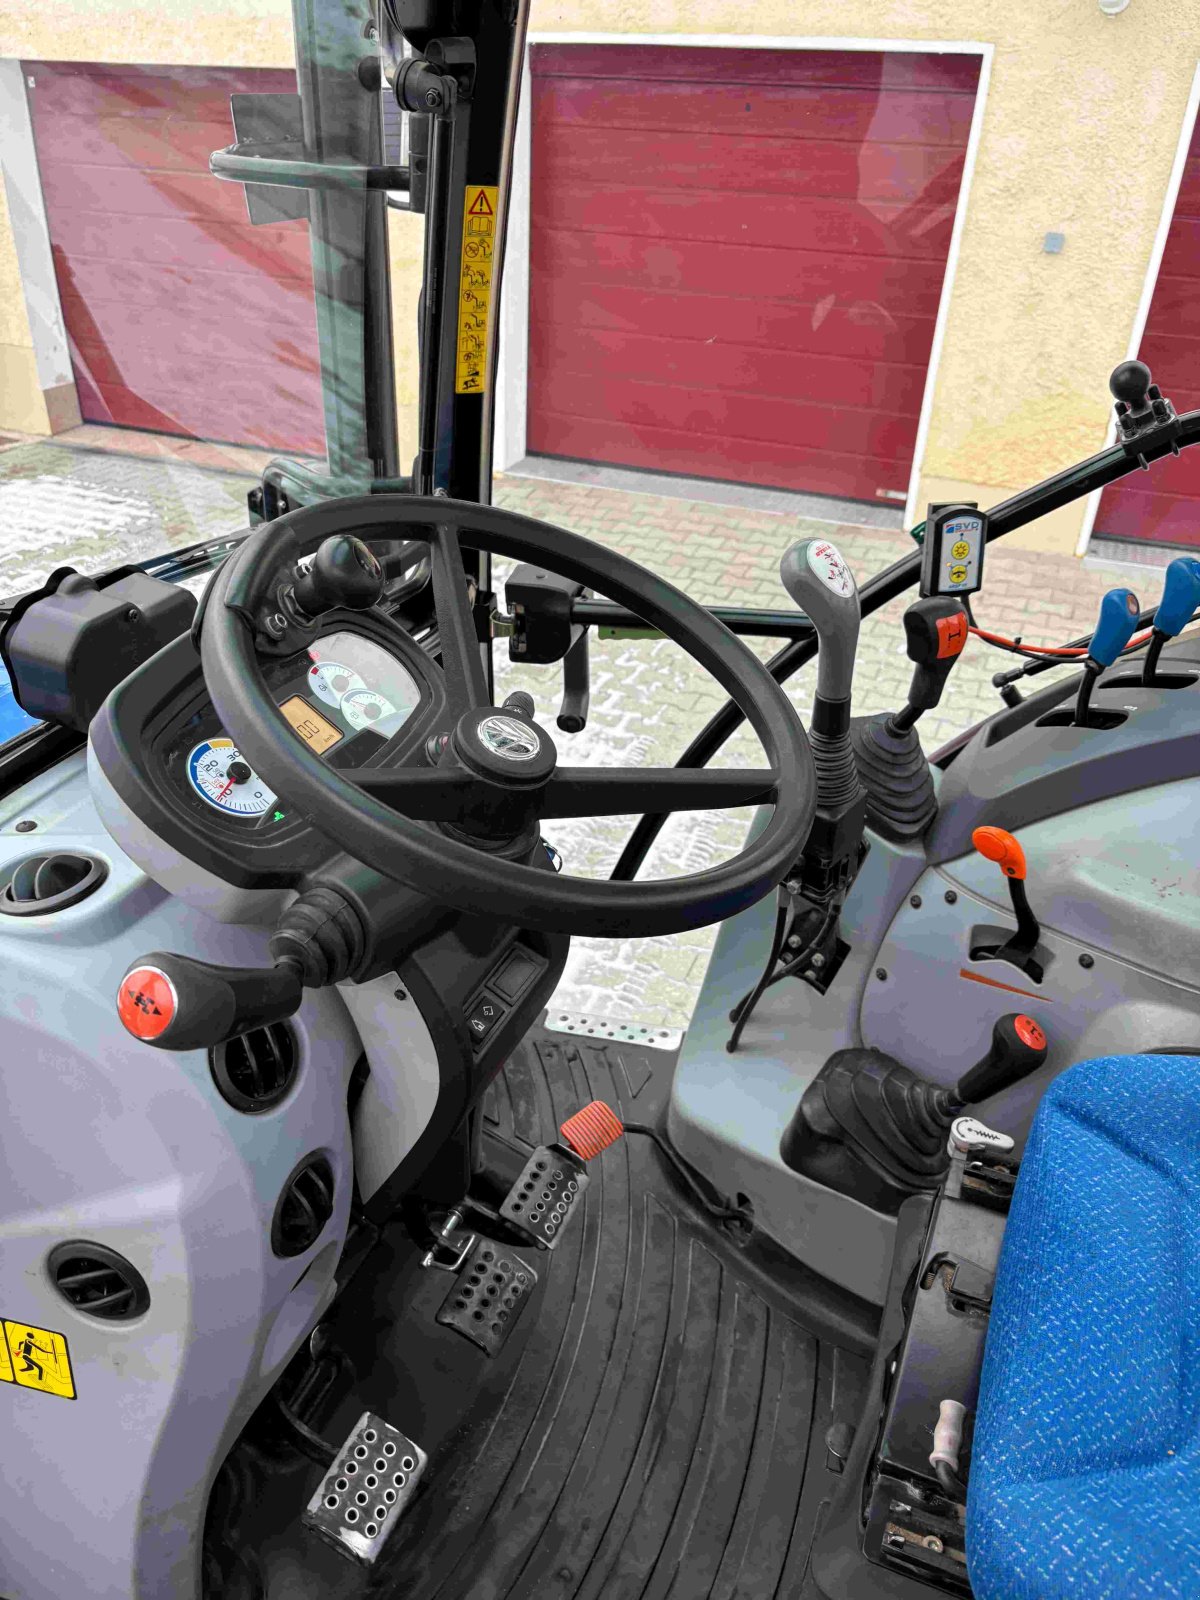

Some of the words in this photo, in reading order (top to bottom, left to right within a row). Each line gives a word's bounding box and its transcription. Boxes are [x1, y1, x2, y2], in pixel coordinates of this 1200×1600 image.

[955, 521, 979, 529] SVD
[203, 760, 218, 772] 20
[254, 791, 263, 799] 0
